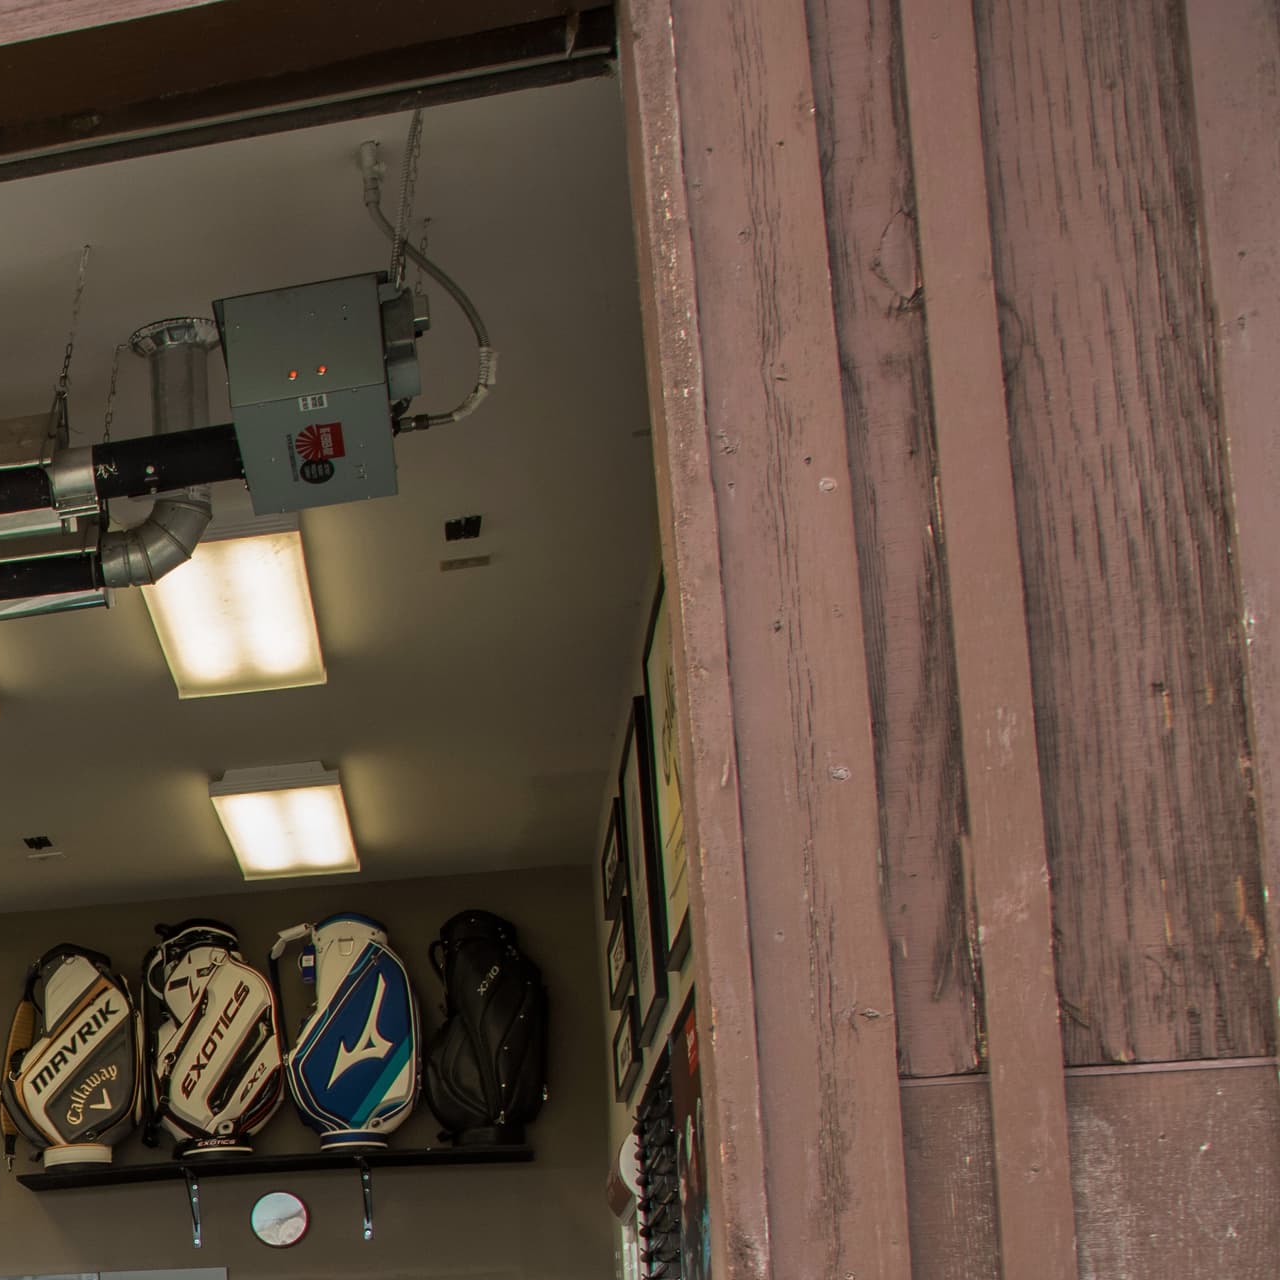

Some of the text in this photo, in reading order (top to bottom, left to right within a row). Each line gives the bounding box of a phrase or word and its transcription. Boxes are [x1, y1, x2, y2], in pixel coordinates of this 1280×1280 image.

[30, 998, 121, 1096] MAVRIK
[180, 980, 250, 1101] EXOTICS
[66, 1063, 119, 1126] Callaway
[196, 1138, 237, 1147] EXOTICS
